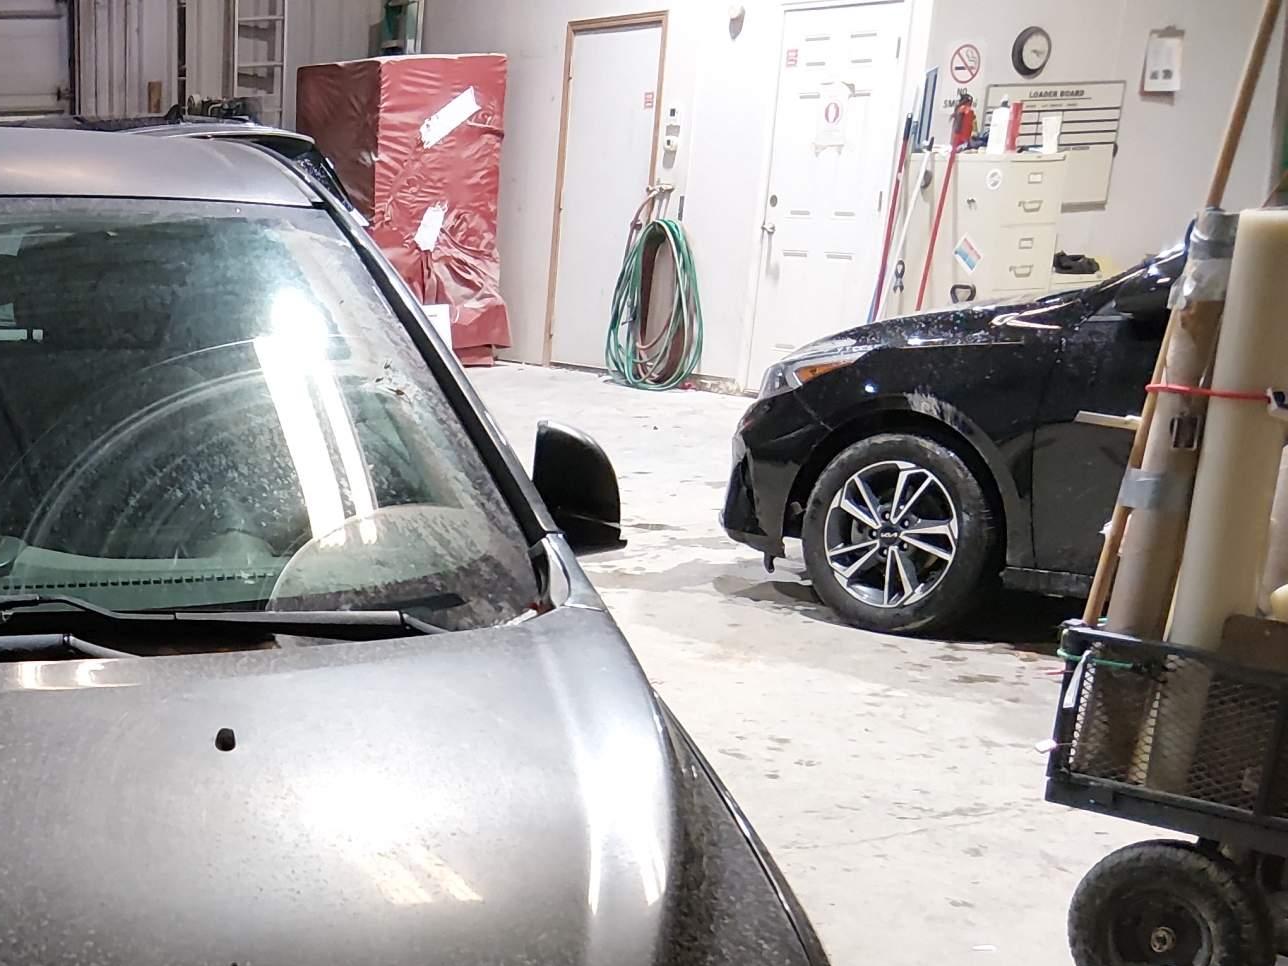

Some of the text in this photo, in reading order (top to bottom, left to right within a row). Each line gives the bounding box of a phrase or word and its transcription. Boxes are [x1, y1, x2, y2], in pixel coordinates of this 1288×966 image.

[957, 88, 967, 96] NO
[1029, 89, 1085, 98] LOADER BOARD
